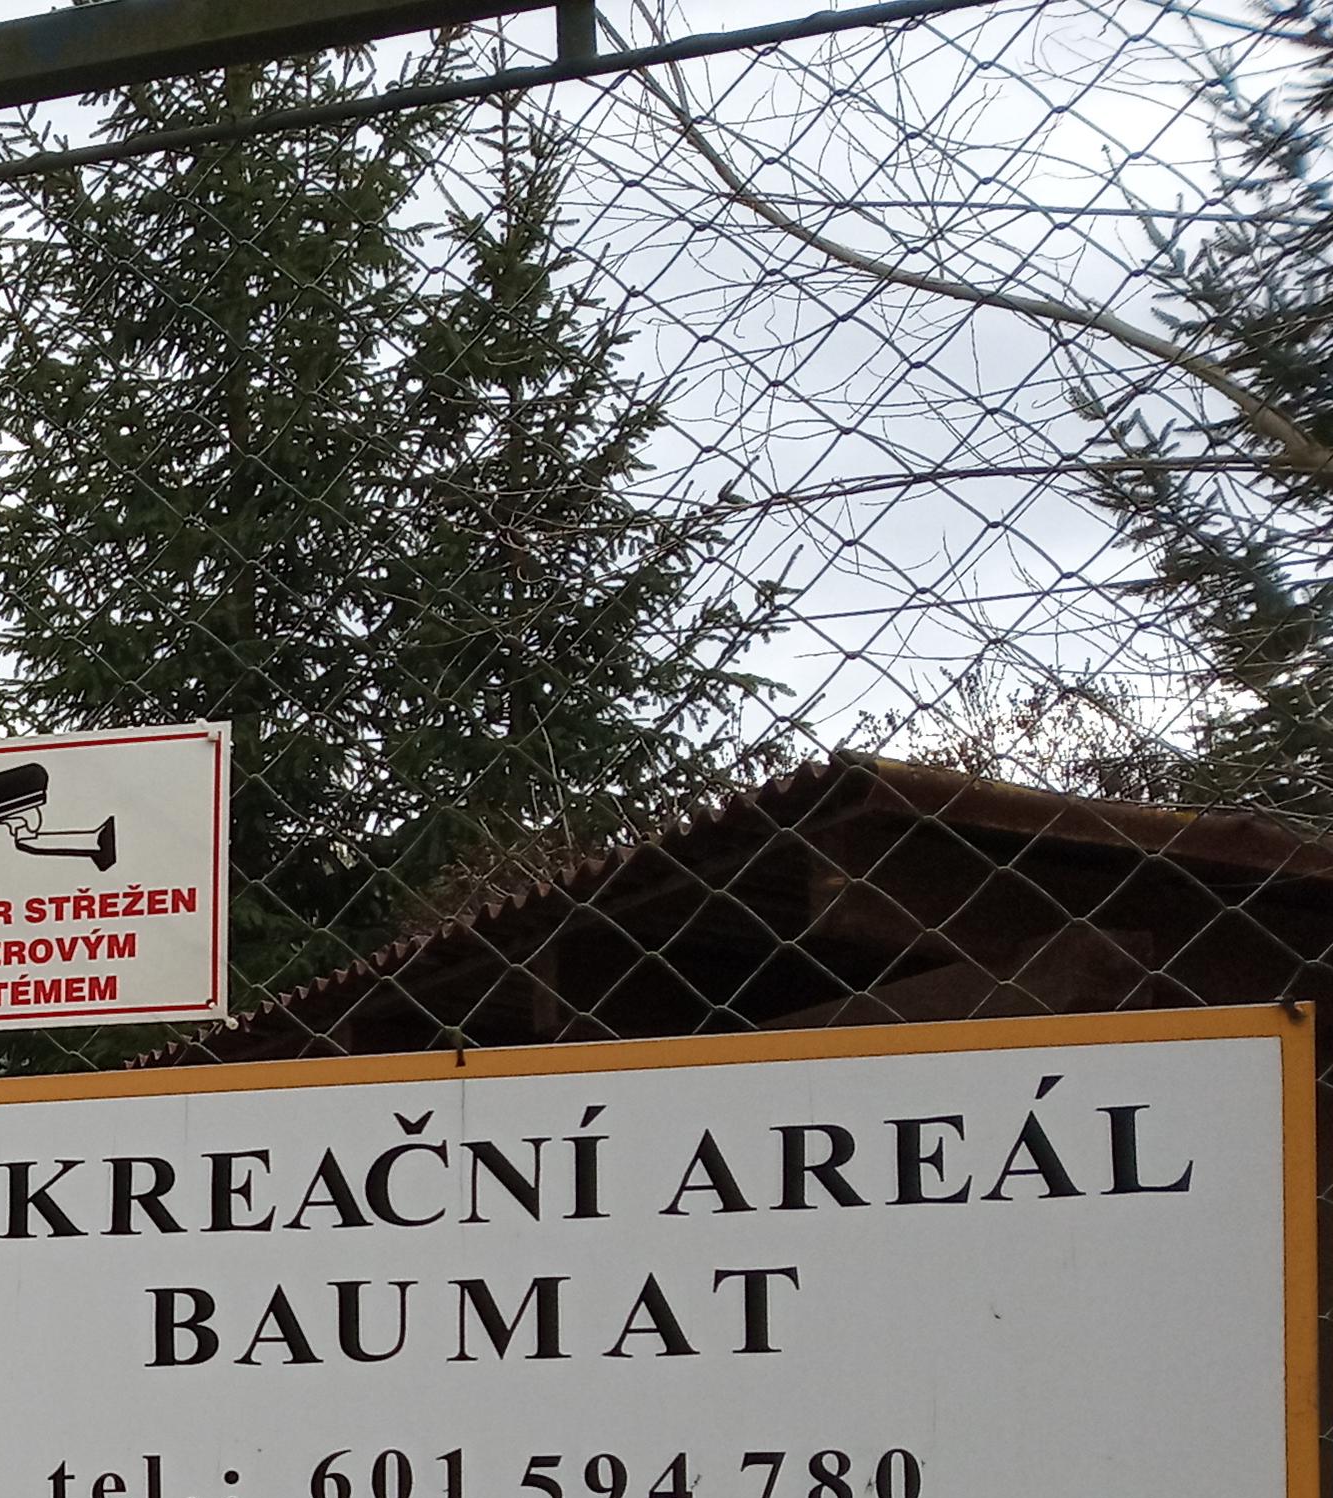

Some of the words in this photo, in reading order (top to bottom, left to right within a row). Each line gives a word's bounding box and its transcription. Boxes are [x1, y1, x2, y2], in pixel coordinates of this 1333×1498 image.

[24, 883, 198, 925] STŘEŽEN
[658, 1074, 1194, 1216] AREÁL
[144, 1266, 800, 1368] BAUMAT
